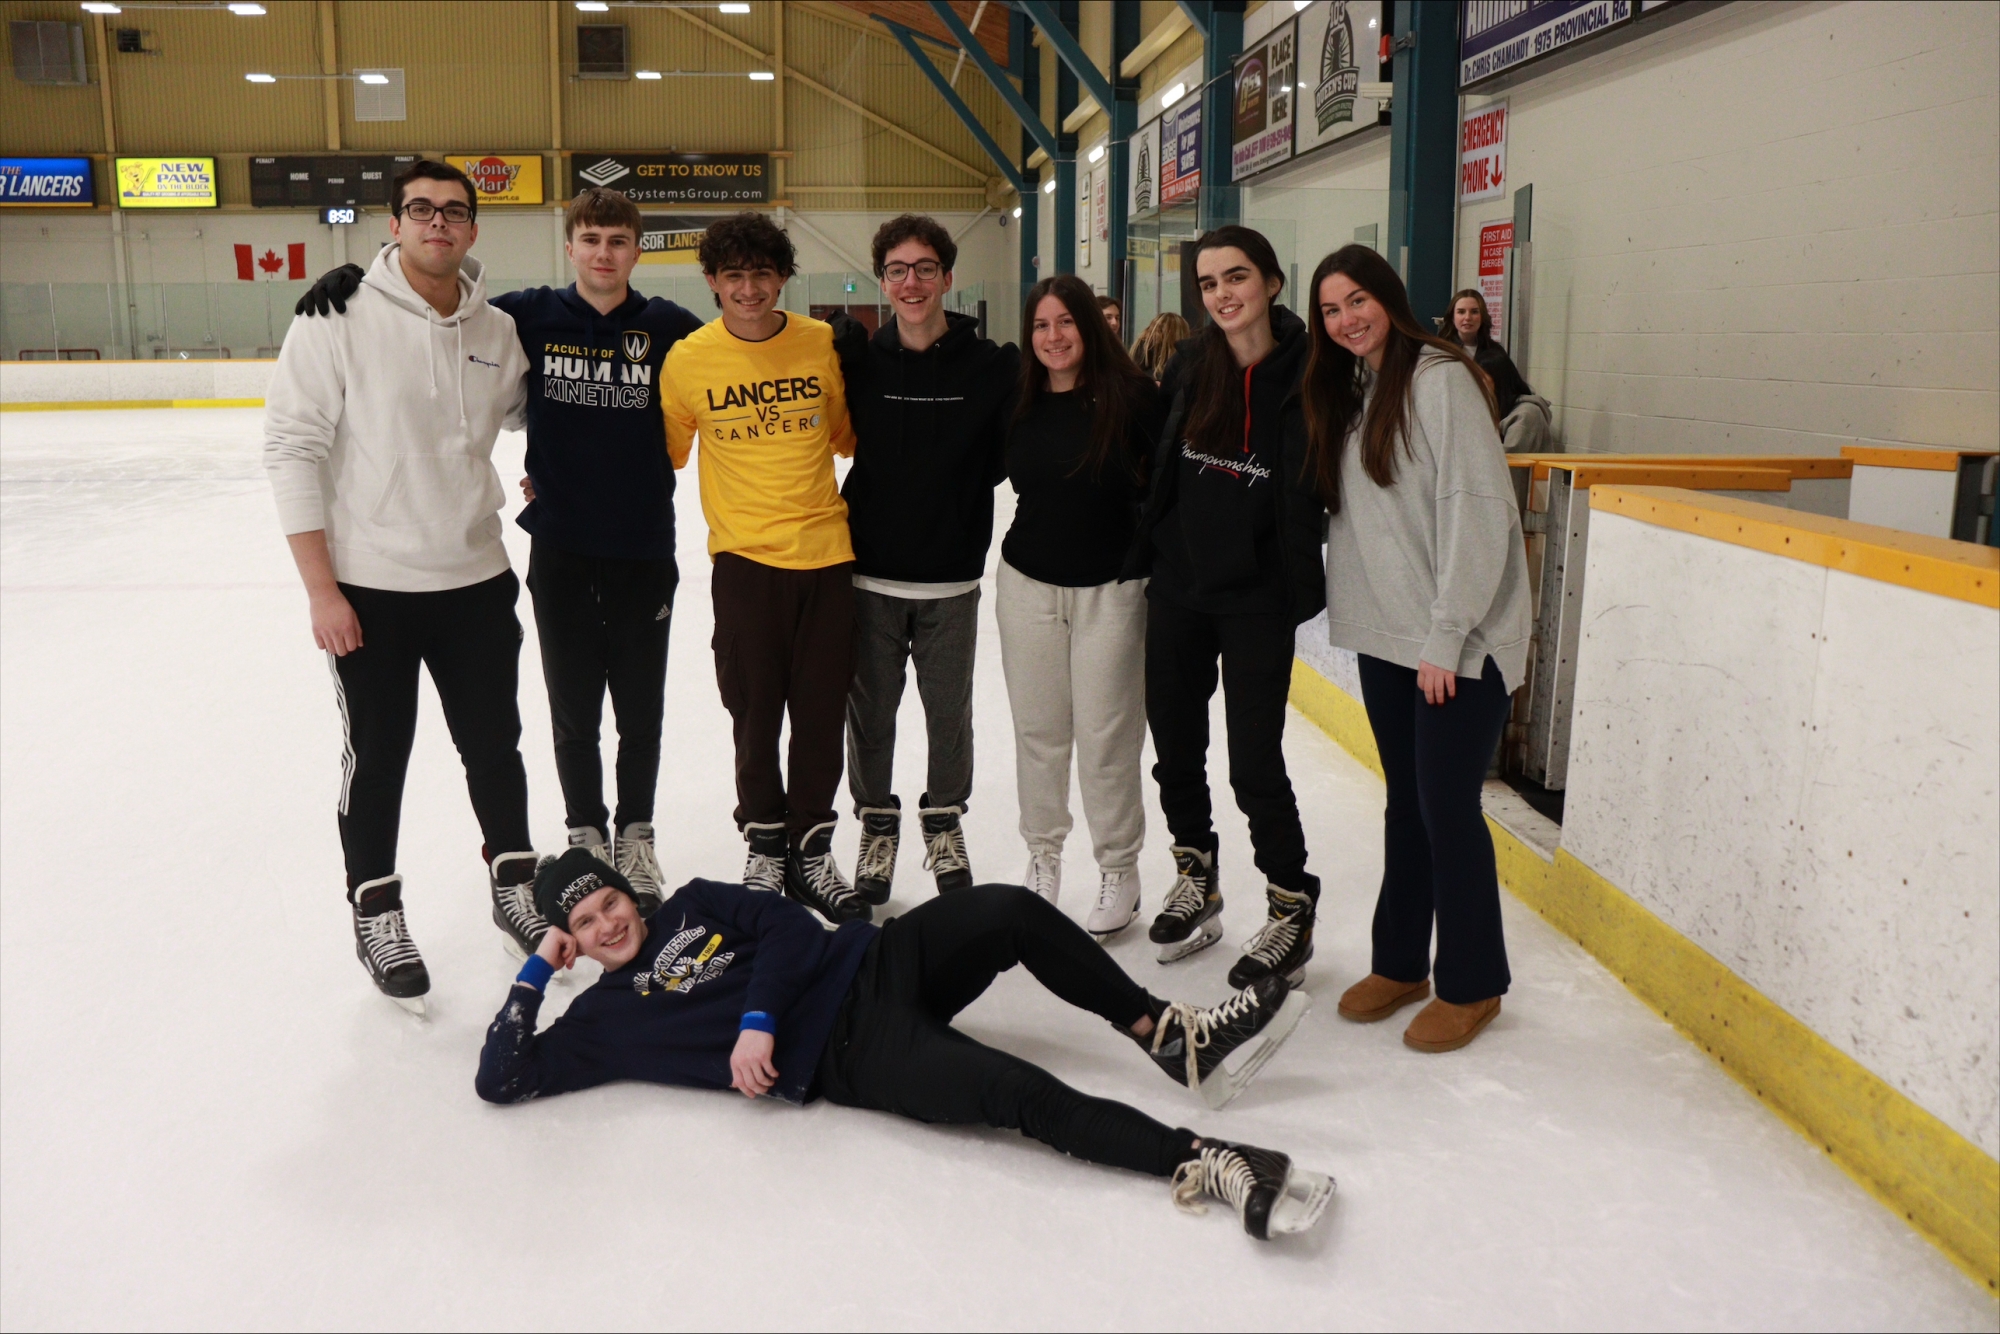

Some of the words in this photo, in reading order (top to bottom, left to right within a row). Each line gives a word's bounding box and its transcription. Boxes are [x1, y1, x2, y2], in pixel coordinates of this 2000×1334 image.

[1271, 34, 1291, 69] PLACE
[1464, 65, 1472, 83] Dr.
[1473, 57, 1491, 79] CHRIS
[1492, 36, 1530, 71] CHAMANDY
[1534, 29, 1552, 54] 1975
[1554, 3, 1609, 45] PROVINCIAL
[1612, 1, 1628, 22] Rd.
[1316, 75, 1342, 108] QUEEN'S
[1343, 73, 1357, 91] CUP
[1272, 94, 1287, 124] HERE
[1463, 108, 1505, 152] EMERGENCY
[1, 166, 22, 175] THE
[157, 174, 210, 183] PAWS
[161, 163, 204, 172] NEW
[362, 172, 382, 180] GUEST
[465, 161, 521, 180] Money
[637, 165, 665, 177] GET
[669, 165, 689, 177] TO
[693, 165, 738, 177] KNOW
[743, 165, 762, 177] US
[1462, 157, 1489, 195] PHONE
[9, 175, 83, 197] LANCERS
[471, 177, 513, 191] Mart
[329, 209, 354, 223] 8:50
[1483, 230, 1500, 242] FIRST
[1501, 228, 1512, 240] AID
[1483, 249, 1489, 257] IN
[1490, 247, 1502, 256] CASE
[545, 343, 597, 357] FACULTY
[601, 349, 615, 358] OF
[543, 355, 651, 385] HUMAN
[544, 376, 650, 409] KINETICS
[707, 376, 821, 411] LANCERS
[756, 405, 780, 422] VS
[715, 418, 808, 440] CANCER
[556, 873, 597, 906] LANCERS
[563, 879, 604, 913] CANCER
[654, 925, 706, 971] KINETICS
[702, 943, 715, 958] 1965
